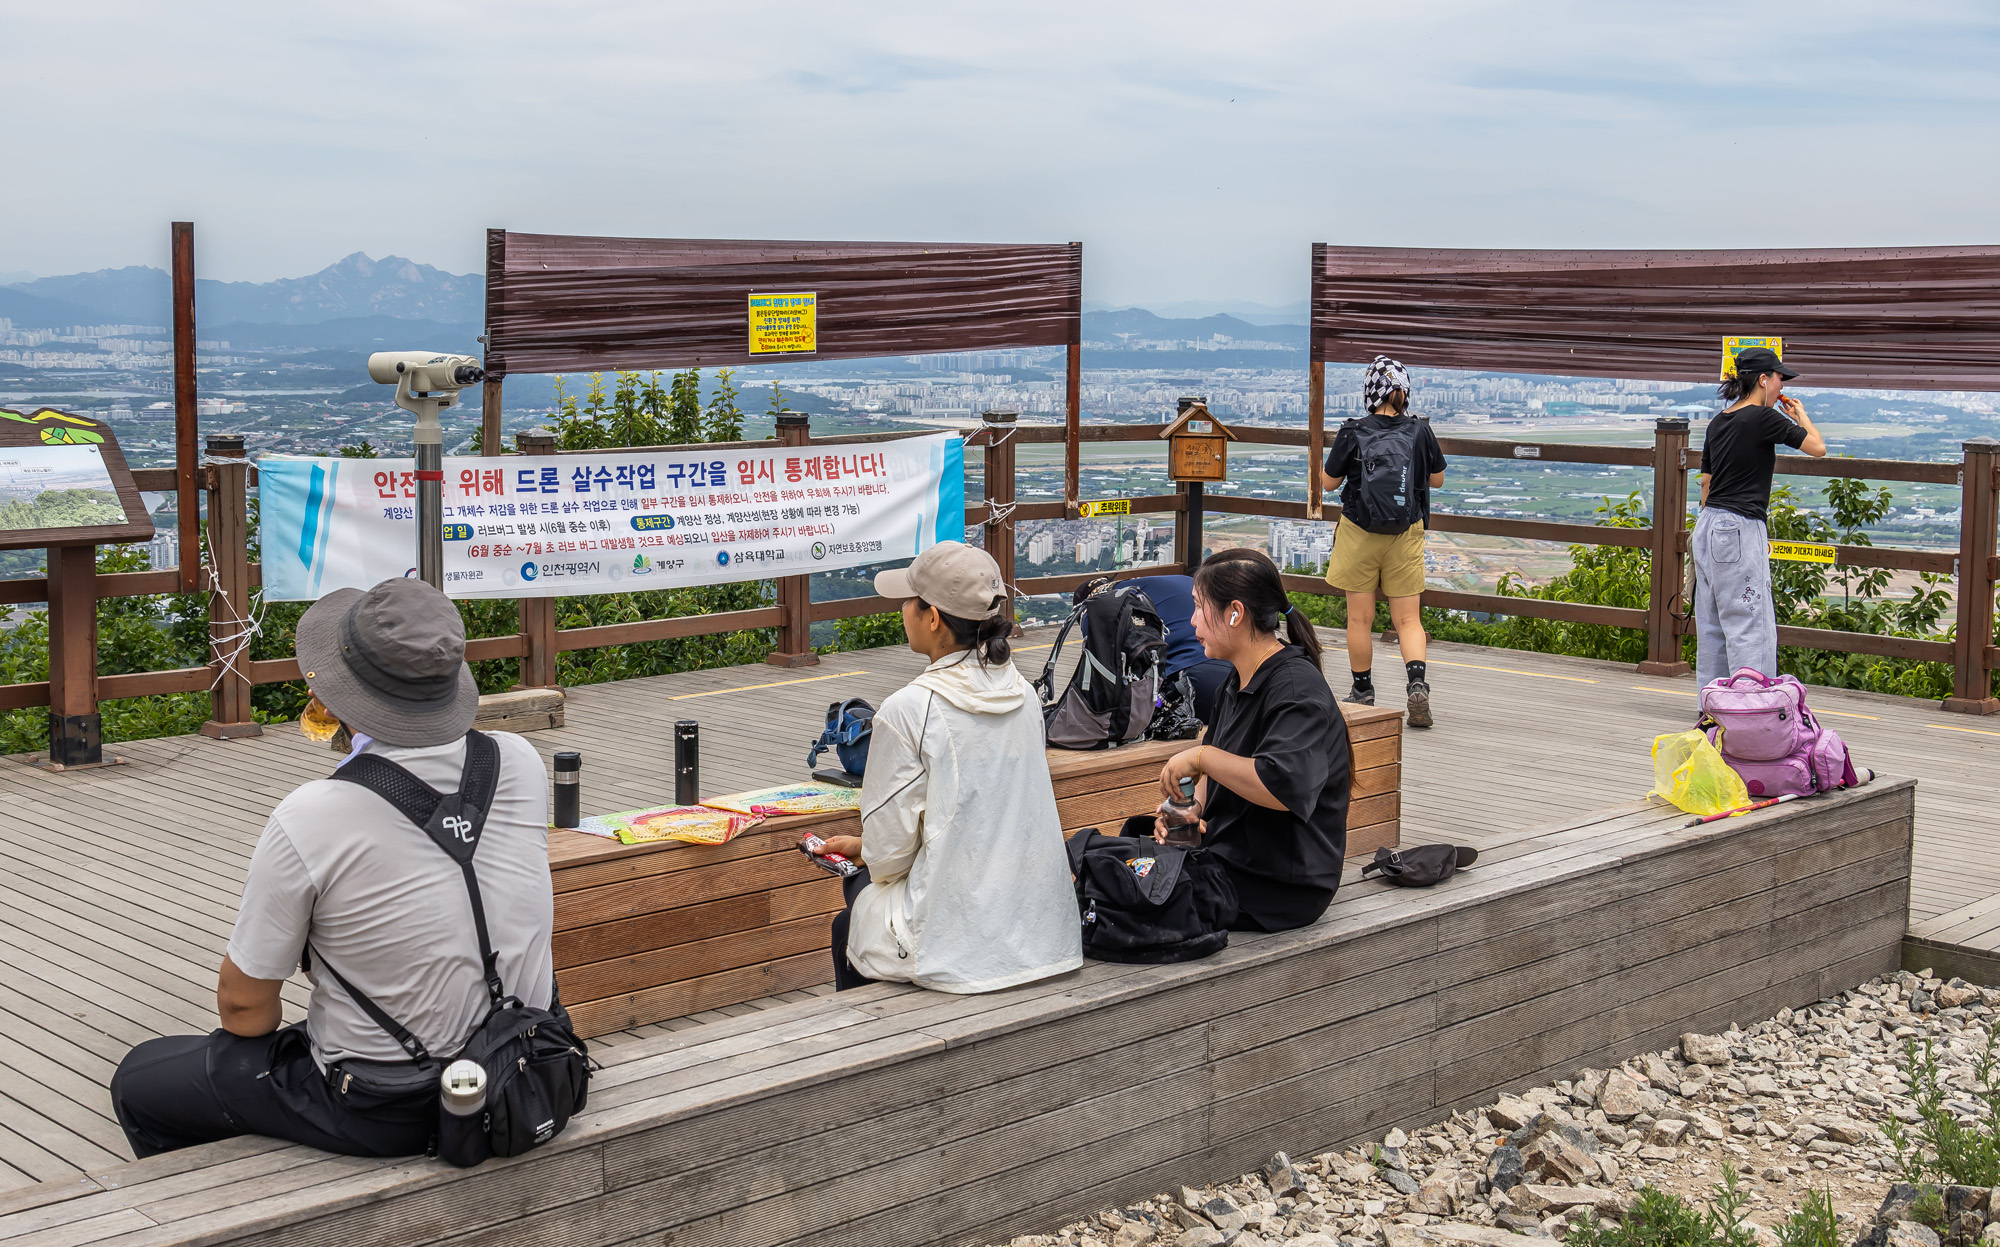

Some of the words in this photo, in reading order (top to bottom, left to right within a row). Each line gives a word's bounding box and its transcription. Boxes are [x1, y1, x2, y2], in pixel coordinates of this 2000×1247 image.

[750, 299, 772, 307] 러브버그
[1739, 338, 1766, 346] 러브버그
[374, 470, 446, 498] 안전
[459, 469, 504, 497] 위해
[516, 467, 560, 493] 드론
[571, 463, 655, 493] 살수작업
[666, 461, 727, 488] 구간을
[737, 458, 775, 485] 임시
[785, 453, 887, 482] 통제합니다!
[383, 506, 413, 520] 계양산
[457, 504, 485, 518] 개체수
[488, 503, 516, 517] 저감을
[519, 502, 538, 516] 위한
[541, 502, 559, 514] 드론
[562, 501, 580, 514] 살수
[583, 500, 618, 512] 작업으로
[620, 498, 638, 511] 인해
[641, 497, 658, 510] 일부
[661, 496, 686, 509] 구간을
[688, 495, 706, 507] 임시
[708, 493, 752, 506] 통제하오니,
[753, 490, 778, 503] 안전을
[780, 489, 805, 501] 위하여
[807, 487, 832, 499] 우회해
[833, 485, 856, 497] 주시기
[858, 483, 890, 495] 바랍니다.
[1101, 501, 1128, 512] 추락위험
[676, 514, 702, 527] 계양산
[704, 513, 725, 525] 정상,
[726, 509, 778, 523] 계양산성(현장
[780, 507, 805, 520] 상황에
[806, 506, 822, 517] 따라
[824, 505, 840, 517] 변경
[842, 503, 861, 515] 가능)
[478, 524, 515, 537] 러브버그
[517, 523, 537, 535] 발생
[539, 521, 567, 534] 시(6월
[569, 520, 587, 533] 중순
[589, 519, 611, 532] 이후)
[636, 516, 671, 530] 통제구간
[467, 544, 489, 558] (6월
[493, 543, 512, 557] 중순
[516, 541, 542, 555] ~7월
[545, 541, 555, 554] 초
[558, 540, 577, 553] 러브
[579, 539, 598, 552] 버그
[600, 536, 636, 551] 대발생할
[638, 535, 664, 548] 것으로
[666, 532, 709, 546] 예상되오니
[711, 530, 736, 543] 입산을
[738, 528, 770, 541] 자제하여
[772, 526, 796, 539] 주시기
[797, 522, 835, 537] 바랍니다.)
[828, 540, 883, 555] 자연보호중앙연맹
[733, 549, 785, 564] 삼육대학교
[1773, 545, 1792, 554] 난간에
[1793, 546, 1813, 556] 기대지
[1814, 548, 1834, 558] 마세요
[542, 561, 600, 577] 인천광역시
[656, 559, 684, 570] 계양구
[444, 570, 484, 582] 생물자원관
